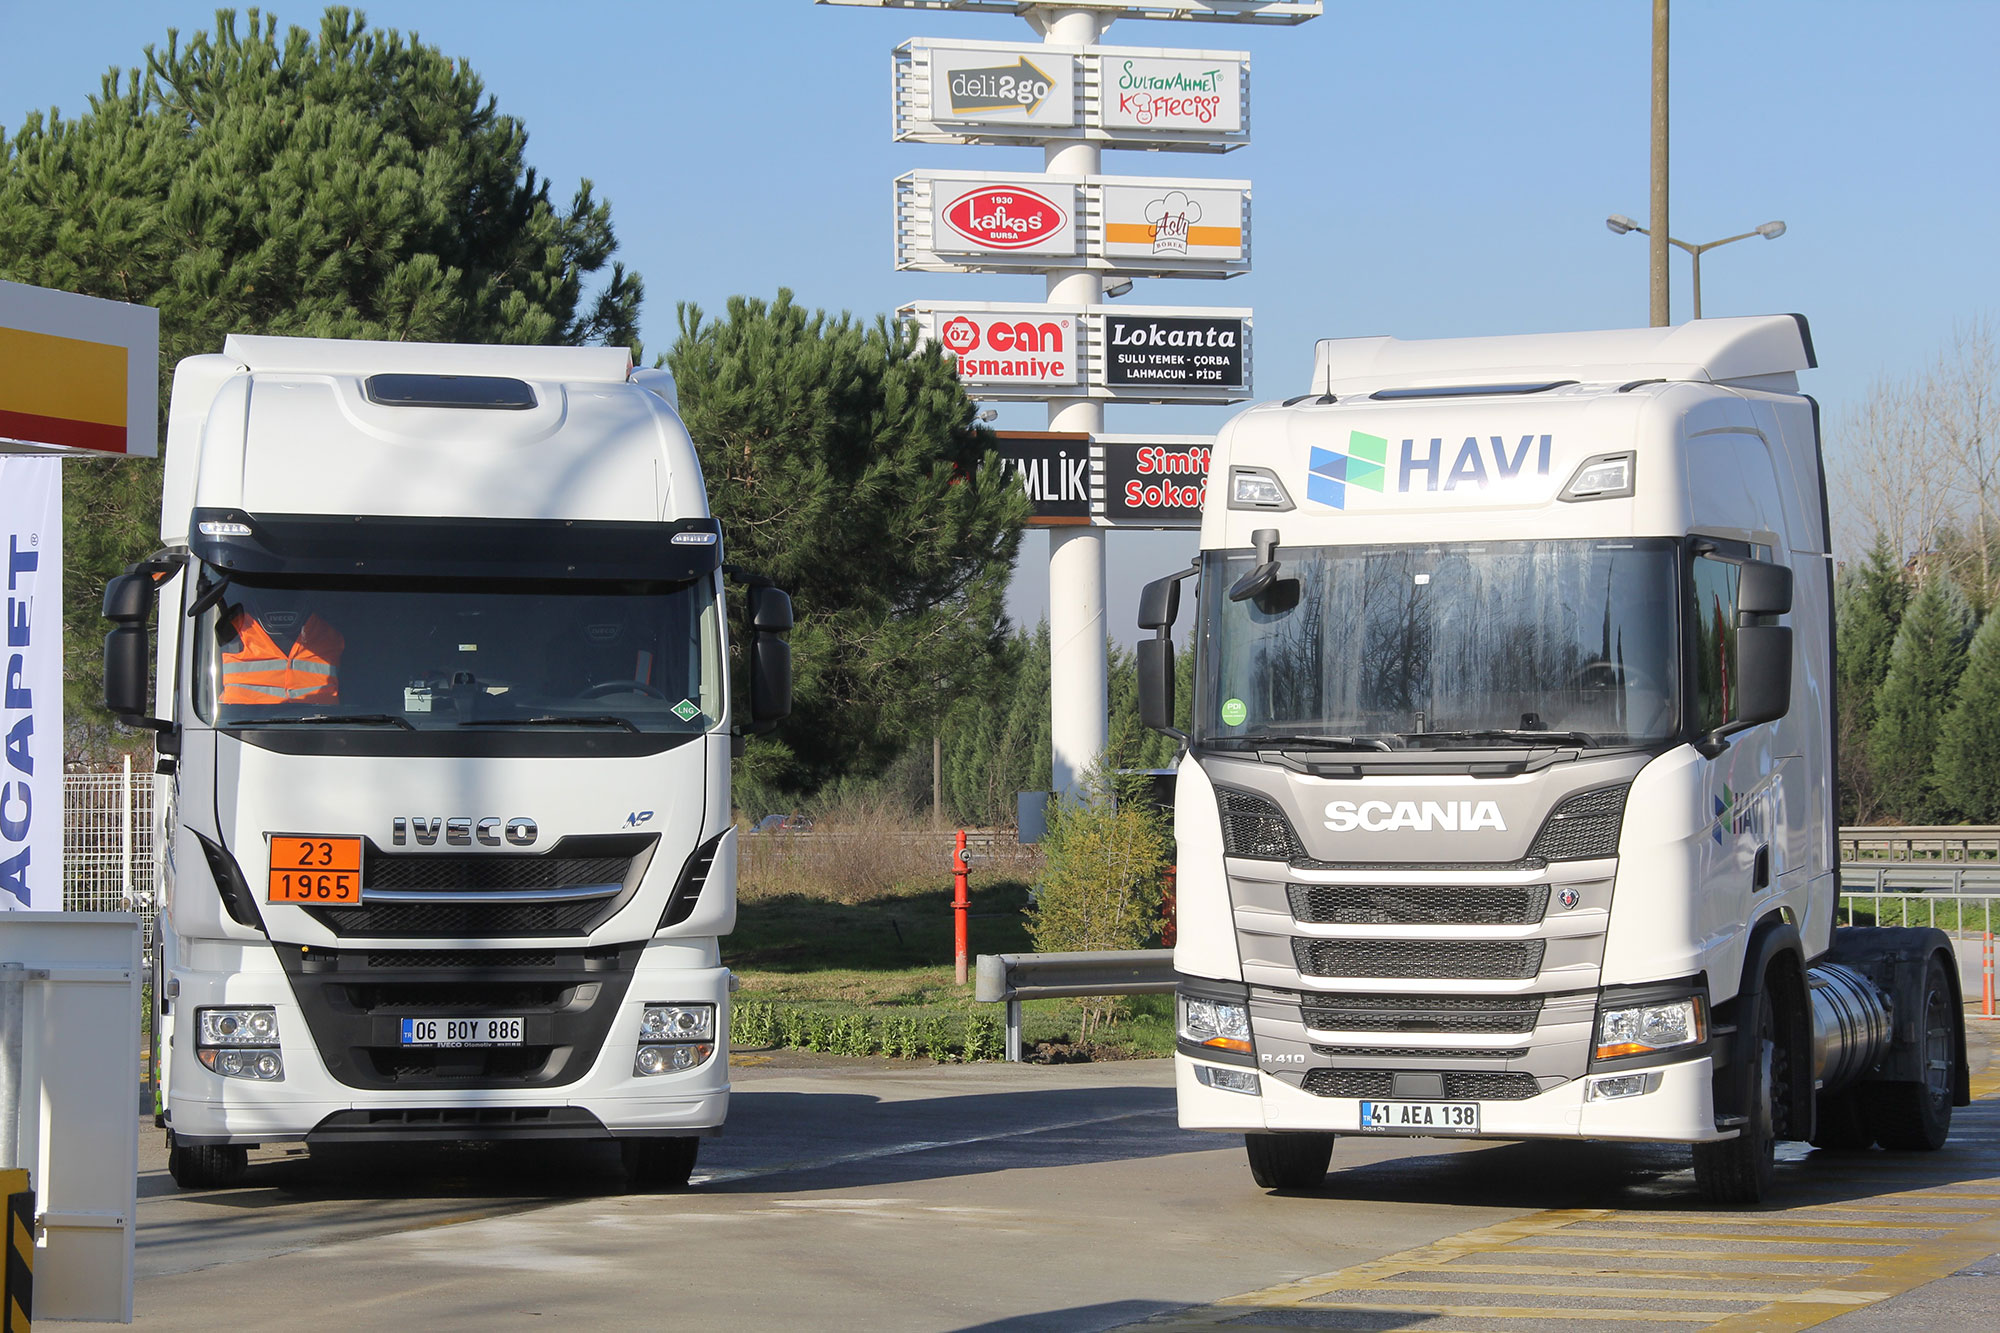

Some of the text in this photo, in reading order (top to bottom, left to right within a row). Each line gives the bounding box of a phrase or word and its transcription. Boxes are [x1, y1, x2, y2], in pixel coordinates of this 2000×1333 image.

[952, 73, 1049, 104] deli2go
[991, 196, 1013, 204] 1930
[969, 199, 1042, 232] kafkas
[987, 321, 1063, 352] can
[1112, 324, 1236, 347] Lokanta
[944, 356, 1064, 380] işmaniye
[1118, 354, 1146, 364] SULU
[1148, 355, 1185, 365] YEMEK
[1193, 355, 1230, 367] ÇORBA
[1126, 368, 1186, 379] LAHMACUN
[1196, 368, 1222, 380] PİDE
[1137, 447, 1210, 474] Simit
[1398, 434, 1552, 493] HAVI
[1323, 800, 1508, 832] SCANIA
[392, 816, 539, 847] IVECO
[298, 841, 333, 866] 23
[282, 874, 350, 899] 1965
[416, 1021, 437, 1040] 06
[447, 1021, 478, 1039] BOY
[488, 1021, 520, 1039] 886
[1261, 1053, 1305, 1064] R 410
[1371, 1105, 1390, 1123] 41
[1401, 1106, 1433, 1124] AEA
[1442, 1107, 1475, 1125] 138
